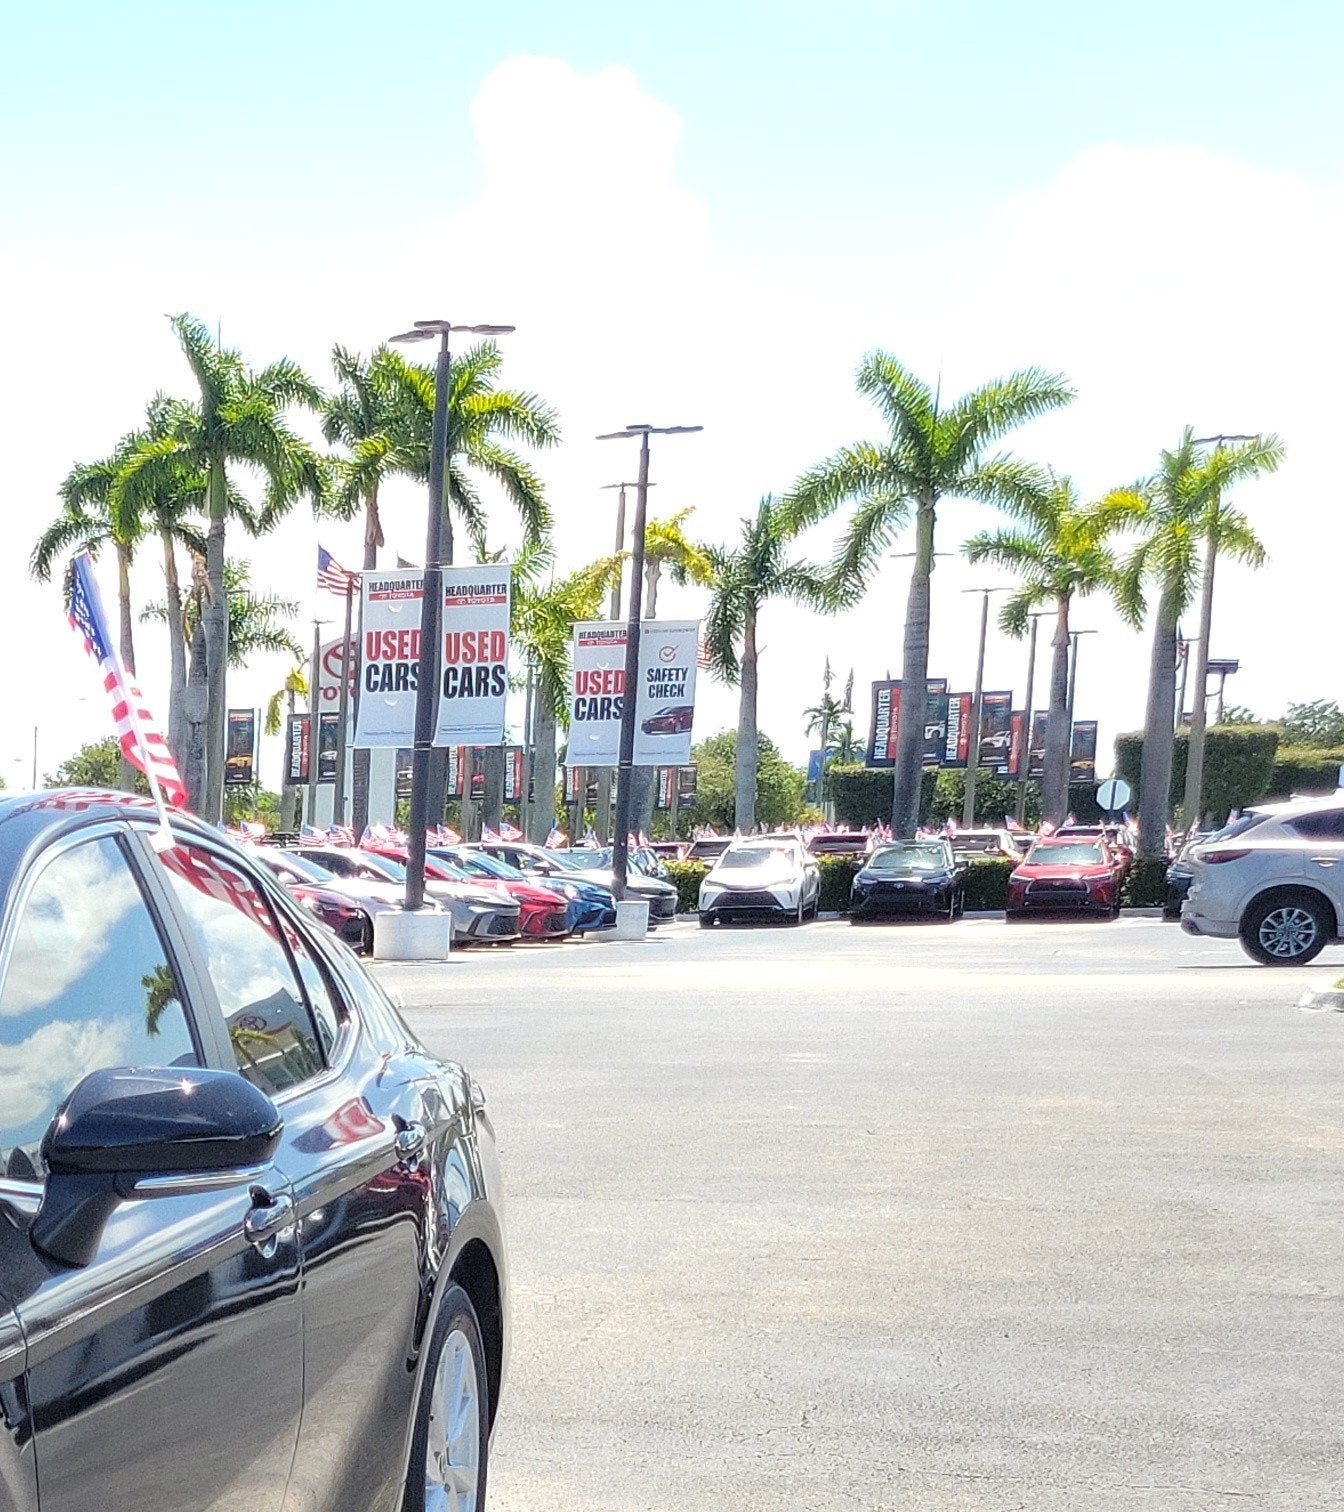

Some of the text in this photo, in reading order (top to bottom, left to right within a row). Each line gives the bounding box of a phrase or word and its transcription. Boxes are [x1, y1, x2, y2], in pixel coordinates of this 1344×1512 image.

[445, 583, 507, 597] HEADQUARTER
[366, 629, 422, 662] USED
[445, 631, 506, 665] USED
[365, 662, 420, 693] CARS
[443, 664, 506, 699] CARS
[575, 669, 625, 696] USED
[647, 667, 688, 683] SAFETY
[648, 683, 685, 698] CHECK
[574, 696, 625, 721] CARS
[873, 689, 891, 760] HEADQUARTER
[945, 697, 961, 761] HEADQUARTER
